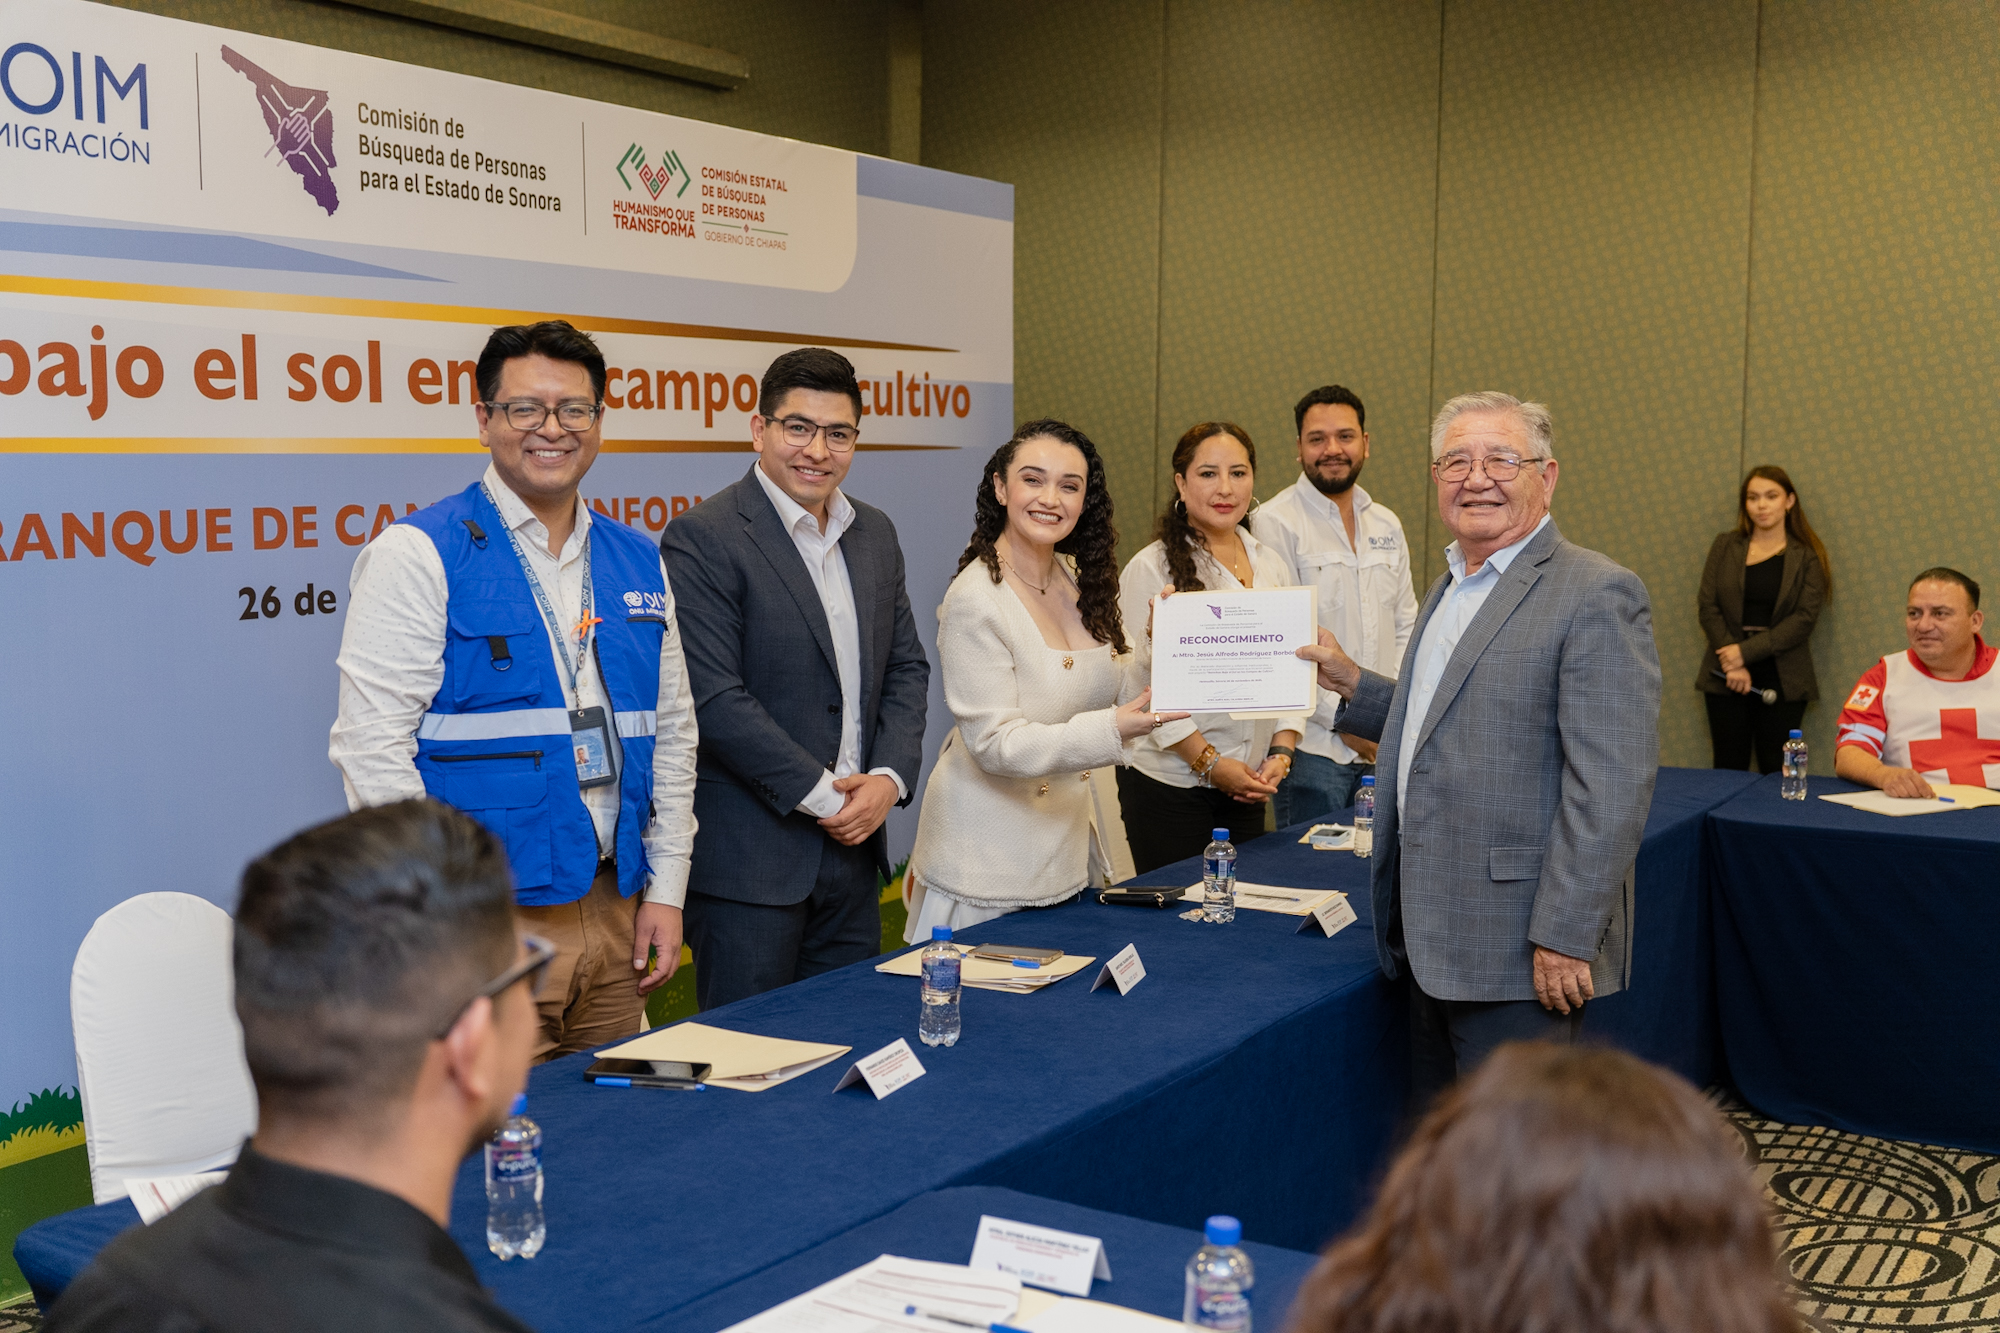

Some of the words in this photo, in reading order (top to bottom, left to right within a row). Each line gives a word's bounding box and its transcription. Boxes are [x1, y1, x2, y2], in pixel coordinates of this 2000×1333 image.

[0, 42, 149, 130] OIM
[358, 102, 439, 135] Comisión
[445, 117, 464, 139] de
[359, 134, 445, 167] Búsqueda
[450, 148, 470, 170] de
[475, 151, 546, 181] Personas
[360, 170, 398, 191] para
[404, 173, 420, 194] el
[425, 174, 479, 201] Estado
[485, 183, 504, 204] de
[509, 186, 561, 212] Sonora
[701, 166, 748, 186] COMISIÓN
[750, 174, 788, 192] ESTATAL
[701, 184, 714, 198] DE
[717, 186, 766, 206] BÚSQUEDA
[613, 199, 674, 220] HUMANISMO
[675, 208, 695, 223] QUE
[613, 213, 696, 239] TRANSFORMA
[702, 203, 715, 216] DE
[717, 205, 765, 223] PERSONAS
[704, 230, 743, 246] GOBIERNO
[745, 235, 755, 247] DE
[756, 237, 787, 251] CHIAPAS
[193, 333, 258, 401] el
[287, 340, 382, 403] sol
[407, 358, 478, 405] en
[861, 370, 971, 418] cultivo
[0, 508, 233, 567] ANQUE
[252, 506, 318, 550] DE
[239, 585, 281, 620] 26
[294, 583, 337, 616] de
[525, 566, 538, 584] OIM
[540, 594, 553, 613] OIM
[1179, 634, 1284, 645] RECONOCIMIENTO
